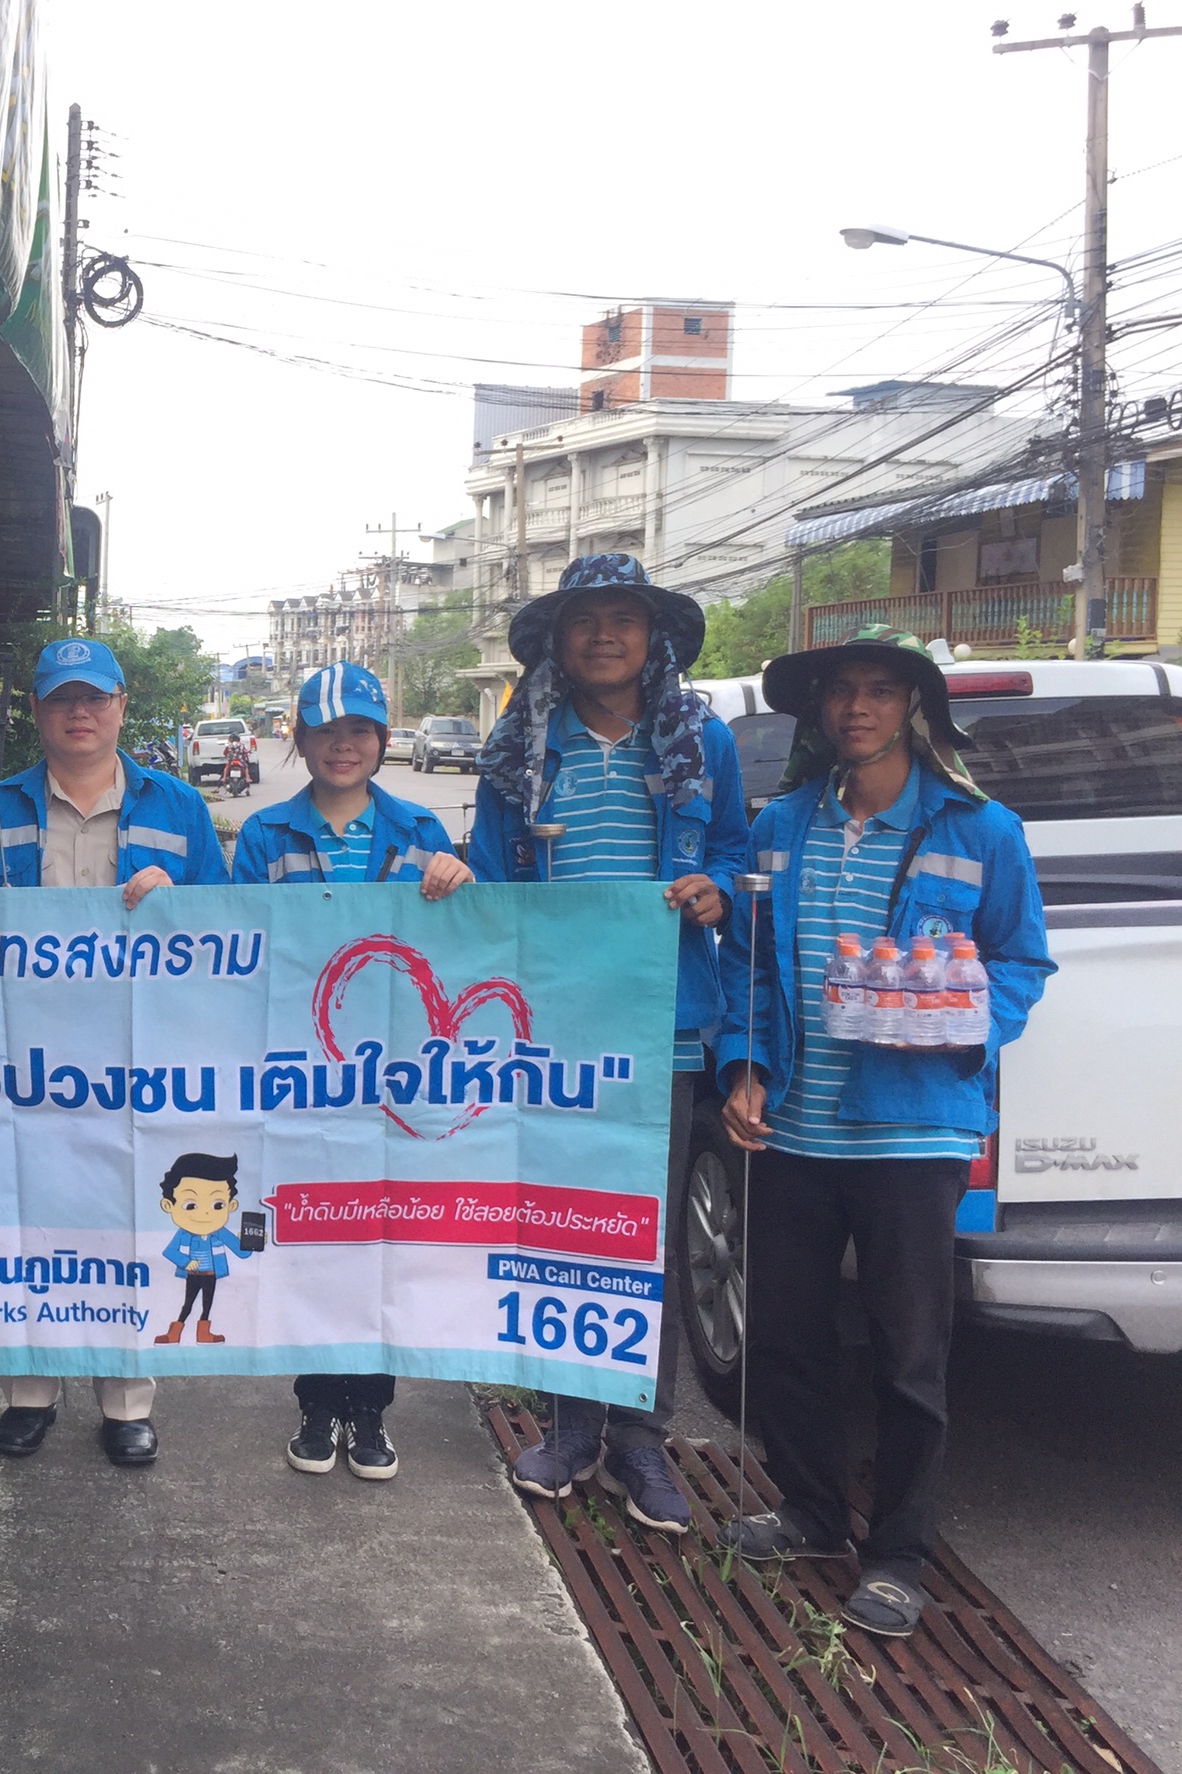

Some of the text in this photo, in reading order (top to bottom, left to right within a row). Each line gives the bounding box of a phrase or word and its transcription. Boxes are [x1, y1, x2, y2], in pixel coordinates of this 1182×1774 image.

[240, 1038, 630, 1112] เติมใจให้กัน"
[1015, 1137, 1097, 1152] ISUZU
[244, 1227, 264, 1237] 1662
[284, 1193, 650, 1237] "น้ำดิบมีเหลือน้อย ใช้สอยต้องประหยัด"
[498, 1259, 652, 1296] PWA Call Center
[36, 1300, 150, 1332] Authority
[497, 1291, 649, 1366] 1662
